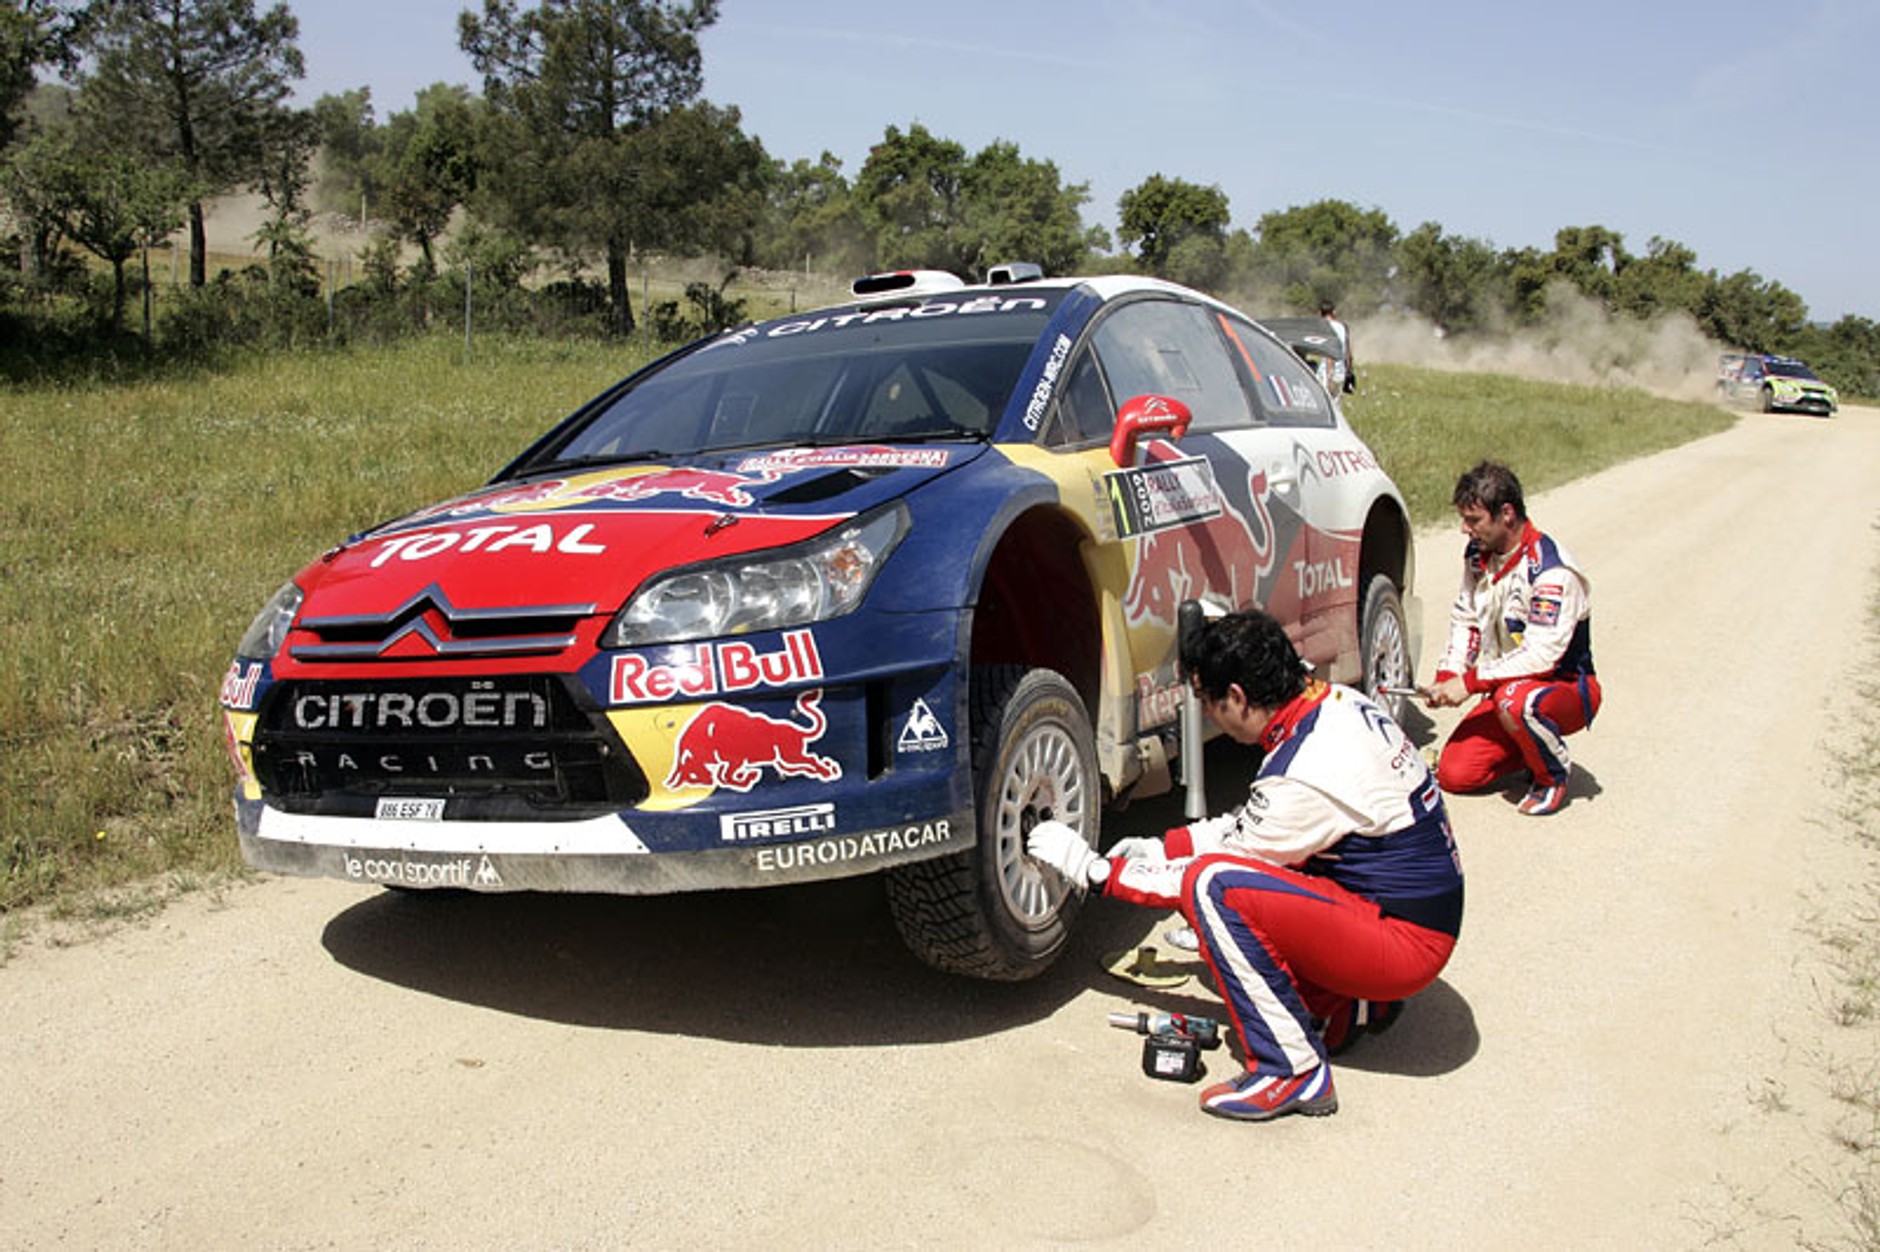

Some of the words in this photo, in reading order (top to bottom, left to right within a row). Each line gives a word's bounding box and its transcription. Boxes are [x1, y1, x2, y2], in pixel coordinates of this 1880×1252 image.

[767, 296, 1047, 338] CITROËN
[370, 524, 606, 568] TOTAL
[1293, 557, 1352, 599] TOTAL
[611, 644, 717, 703] Red
[718, 629, 823, 690] Bull
[295, 681, 546, 729] CITROËN
[297, 751, 552, 772] RACING
[400, 803, 423, 817] ESF
[721, 804, 835, 840] PIRELLI
[757, 820, 951, 871] EURODATACAR
